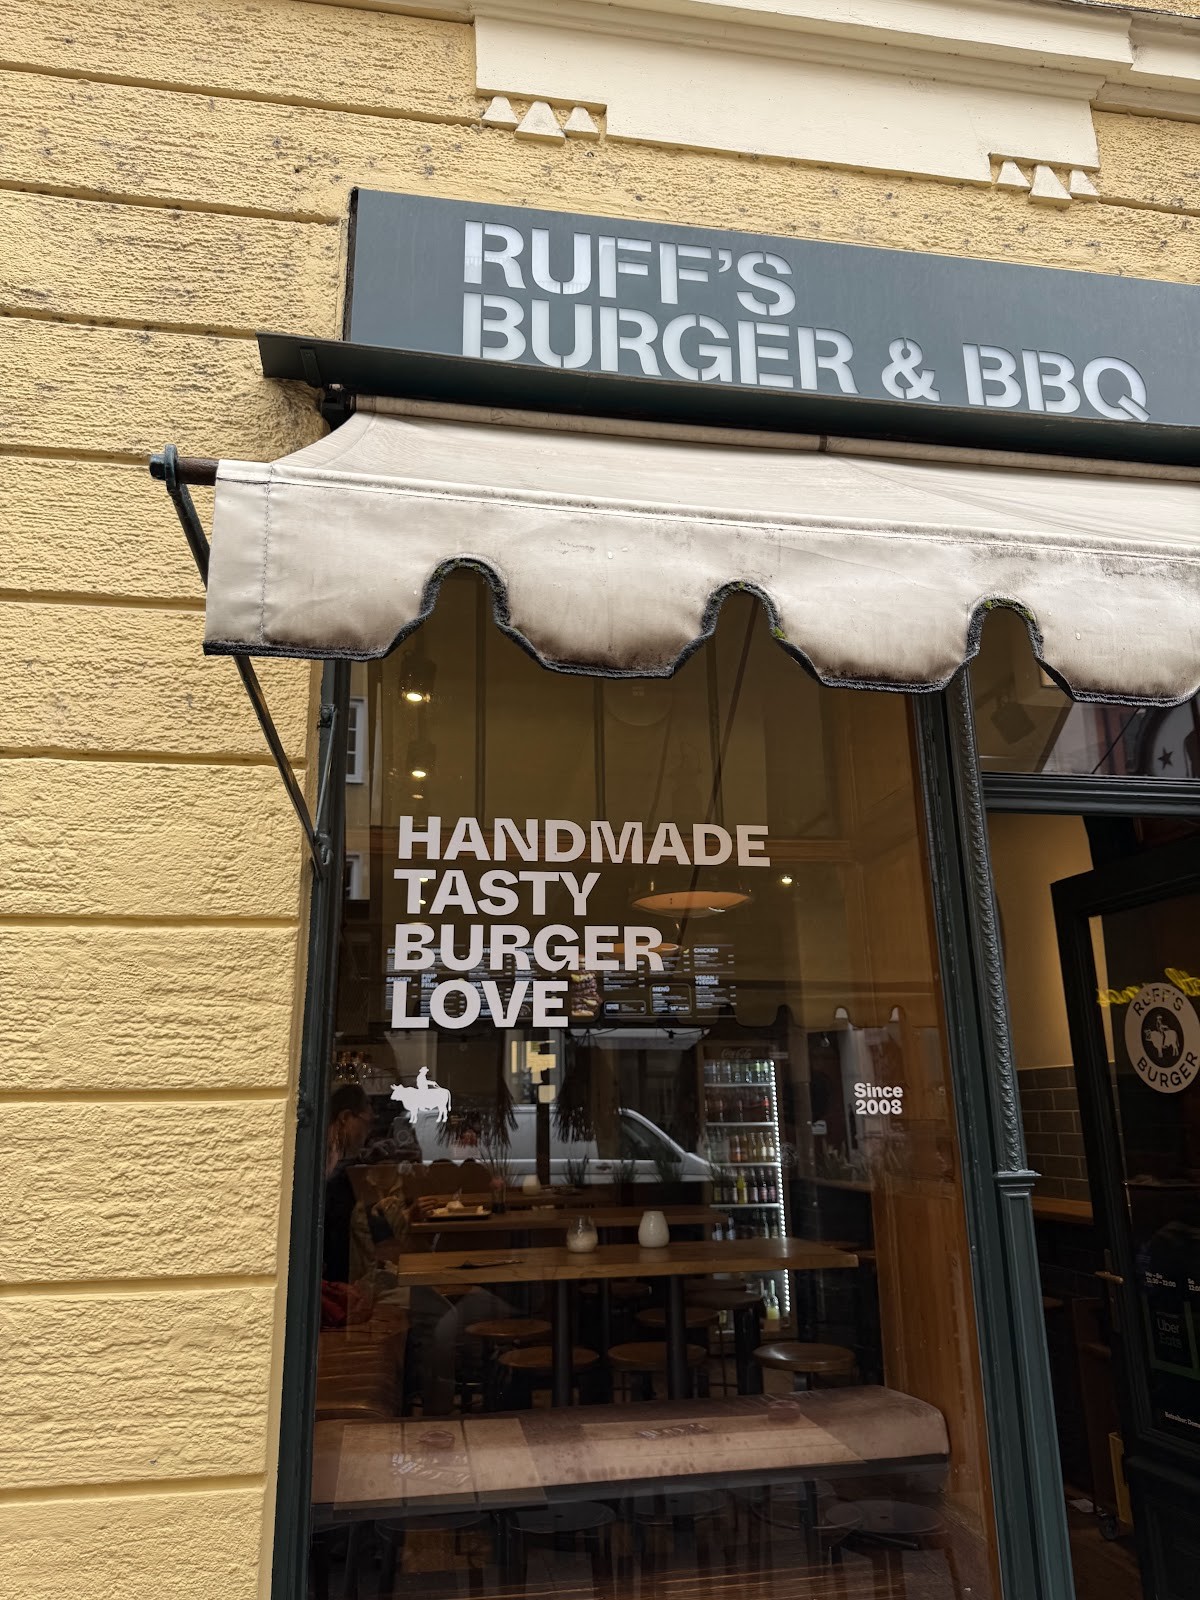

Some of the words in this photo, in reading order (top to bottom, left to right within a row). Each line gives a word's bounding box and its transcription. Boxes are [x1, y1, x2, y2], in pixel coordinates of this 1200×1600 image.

[463, 220, 796, 317] RUFF'S
[462, 292, 860, 395] BURGER
[881, 337, 941, 402] &
[962, 342, 1151, 422] BBQ
[398, 815, 771, 868] HANDMADE
[393, 869, 601, 917] TASTY
[393, 924, 665, 972] BURGER
[391, 980, 569, 1029] LOVE
[854, 1082, 903, 1098] Since
[1137, 1051, 1198, 1088] BURGER
[855, 1099, 903, 1115] 2008
